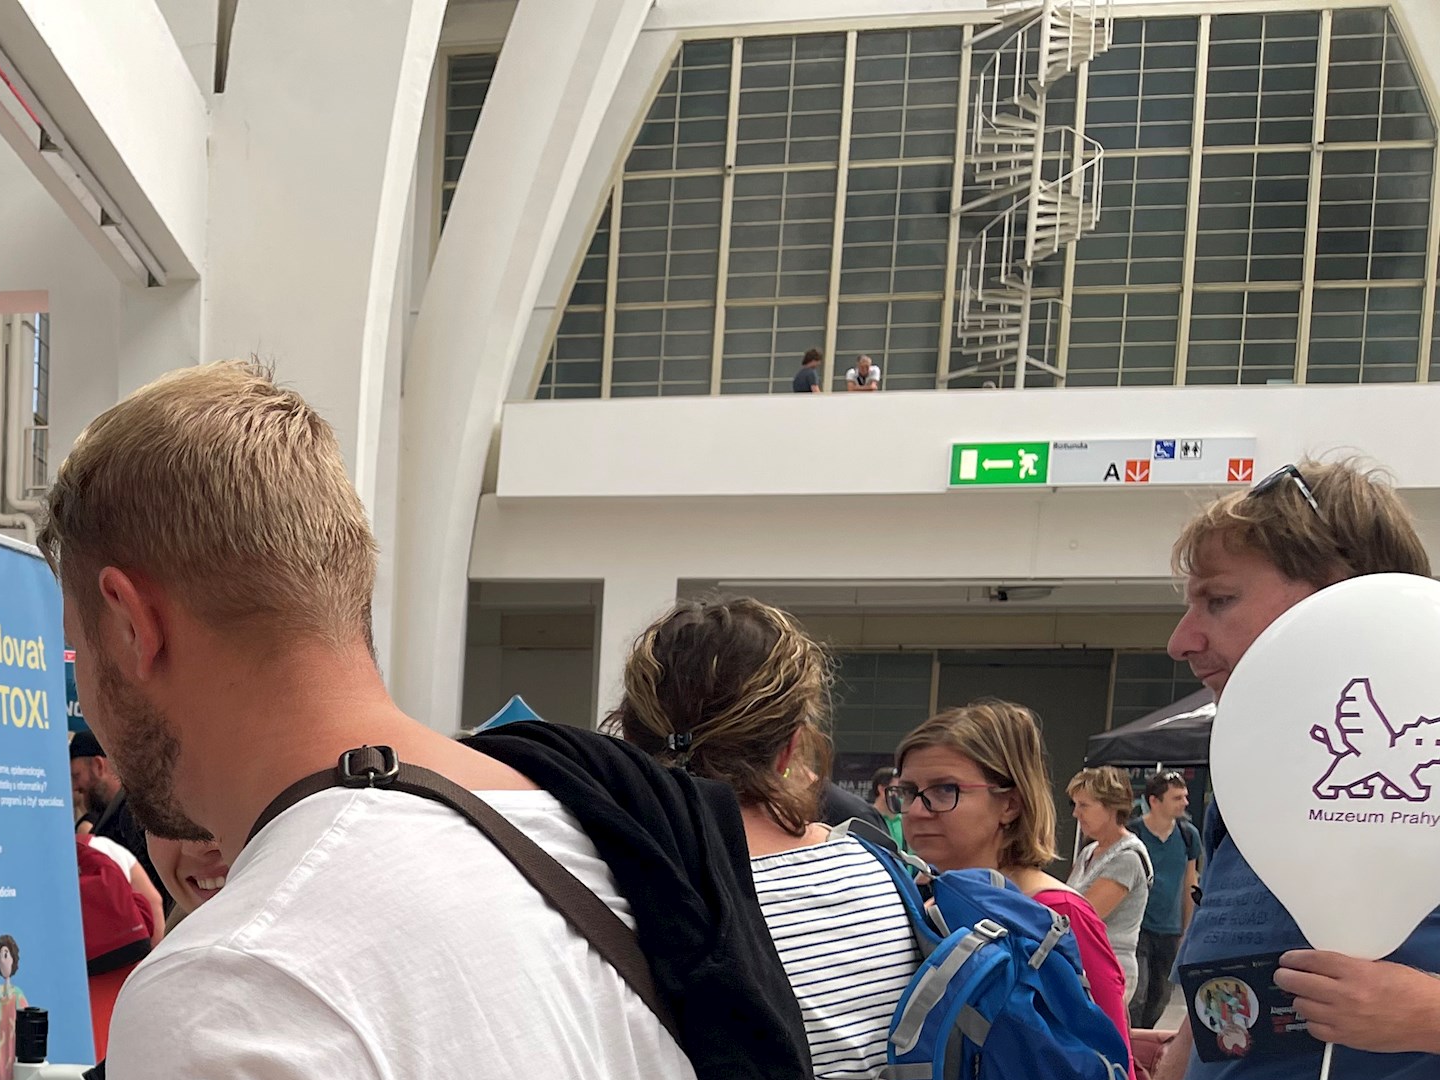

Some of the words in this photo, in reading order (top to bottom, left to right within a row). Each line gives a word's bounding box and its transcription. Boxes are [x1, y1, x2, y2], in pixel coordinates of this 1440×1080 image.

[1103, 463, 1120, 481] A
[1309, 808, 1384, 824] Muzeum
[1390, 810, 1440, 828] Prahy
